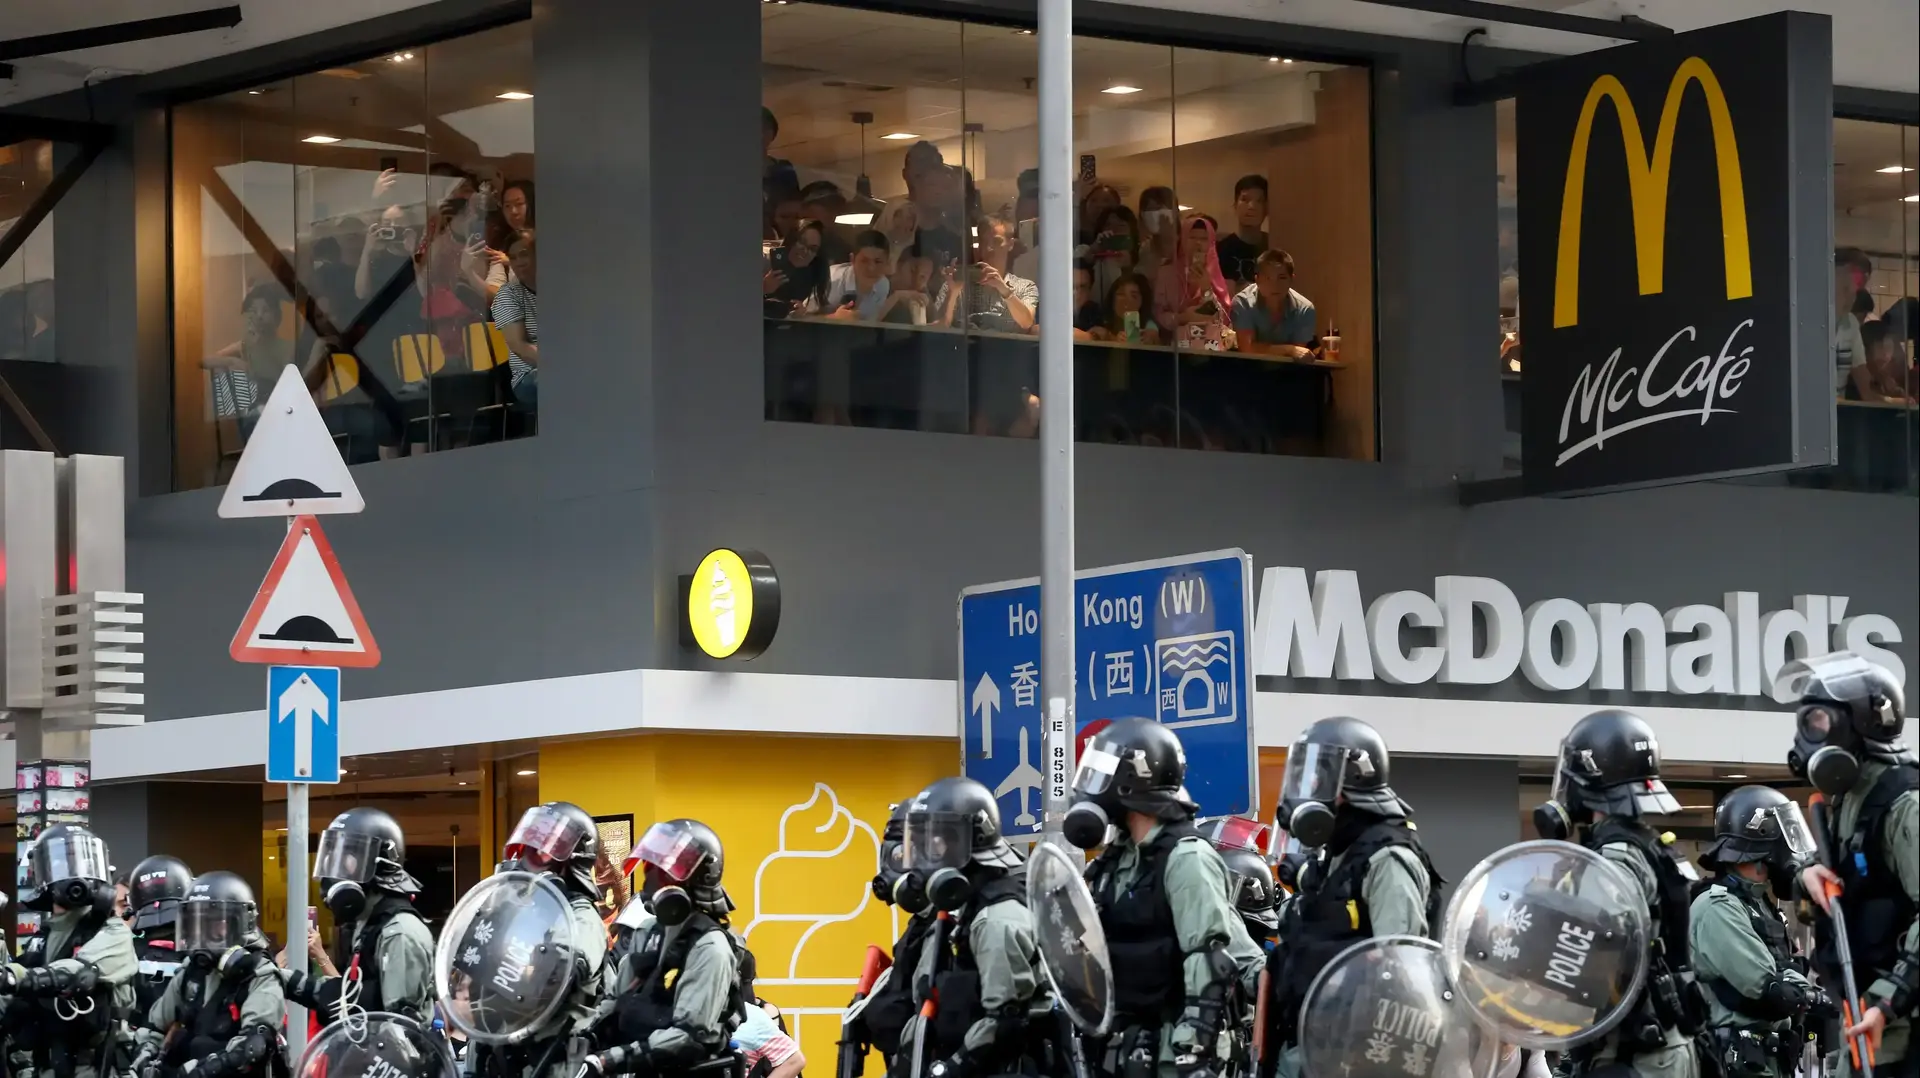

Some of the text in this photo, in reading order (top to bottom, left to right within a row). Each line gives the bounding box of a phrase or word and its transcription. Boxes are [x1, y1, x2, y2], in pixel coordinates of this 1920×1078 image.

[1557, 318, 1754, 451] McCafé
[1008, 577, 1206, 637] Ho Kong (W)
[1254, 565, 1907, 704] McDonald's
[1161, 687, 1177, 712] 西
[1217, 681, 1229, 705] W
[1052, 721, 1065, 798] E 8585
[1492, 904, 1533, 962] 警察
[1544, 920, 1596, 989] POLICE
[492, 936, 535, 993] POLICE
[1372, 997, 1442, 1048] POLICE
